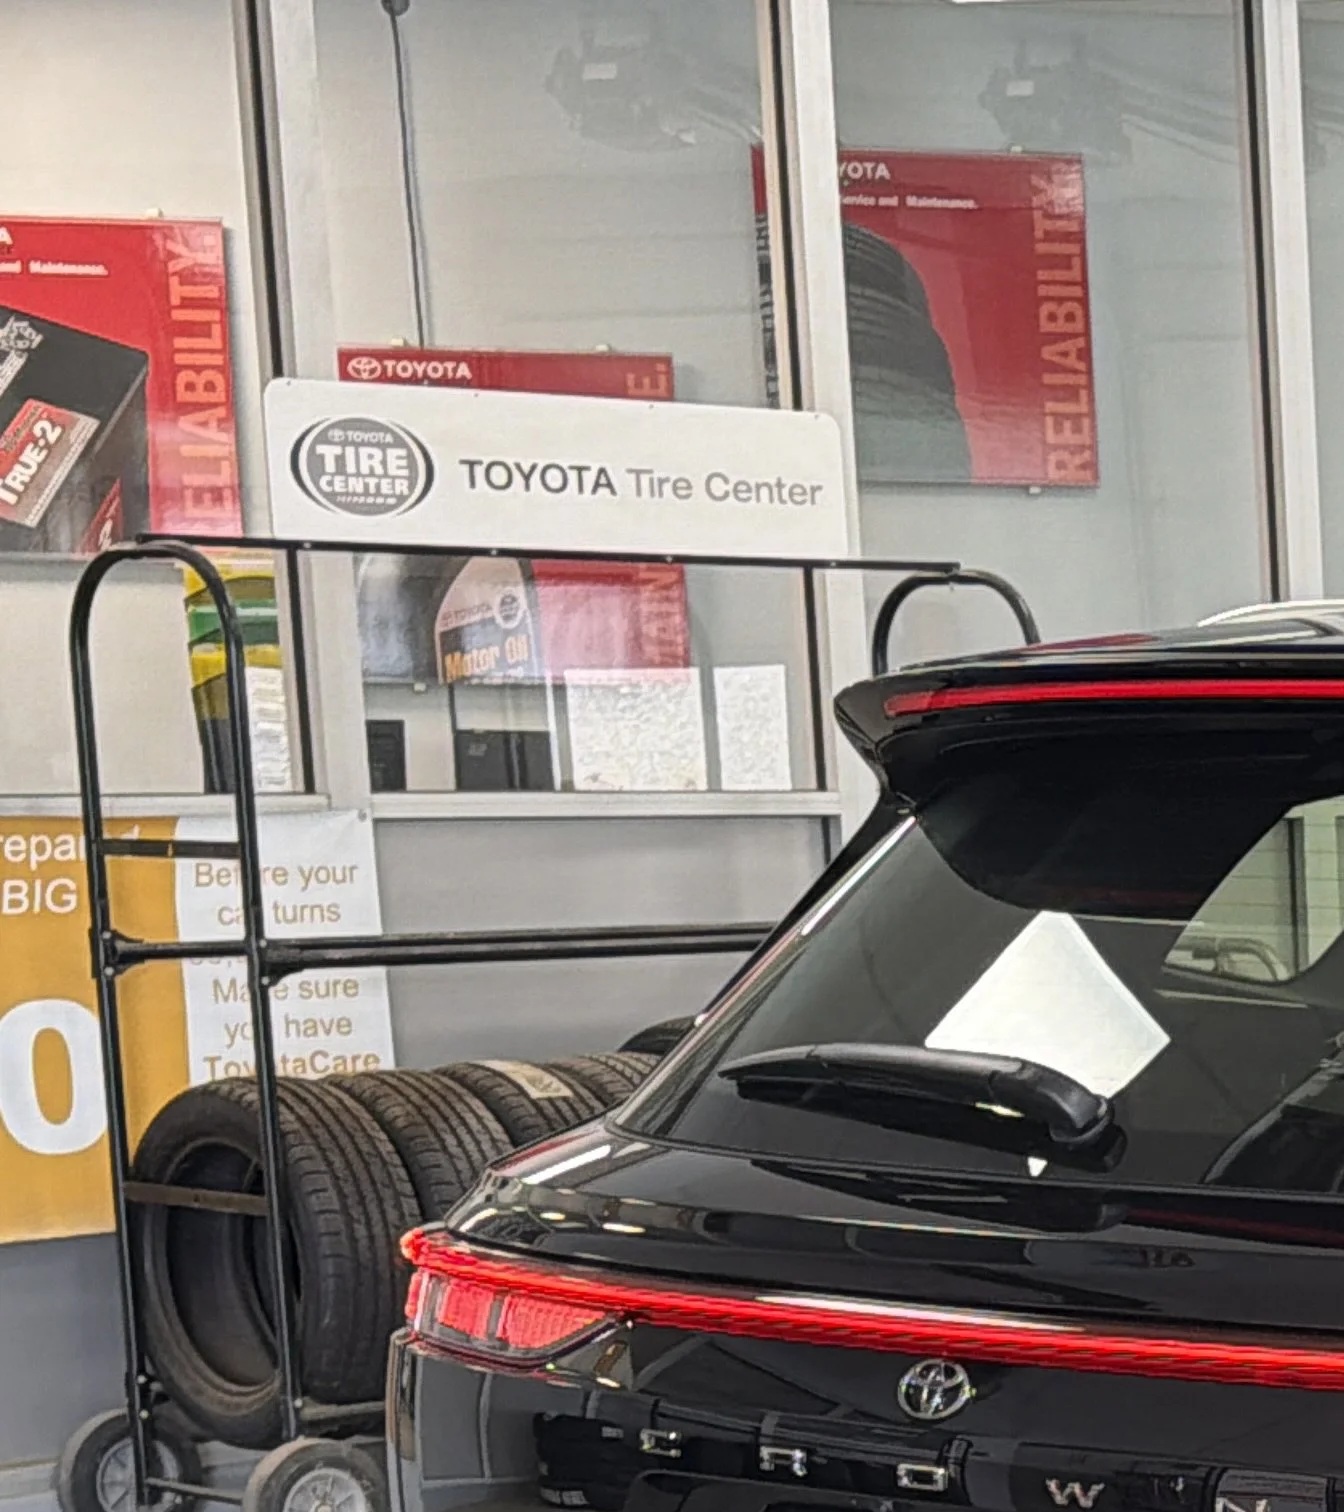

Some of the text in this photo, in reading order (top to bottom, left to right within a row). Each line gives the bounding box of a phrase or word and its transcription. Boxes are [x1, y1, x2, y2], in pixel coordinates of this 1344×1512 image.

[166, 233, 234, 519] ELIABILITY.
[381, 359, 473, 379] TOYOTA
[345, 430, 394, 445] TOYOTA
[315, 444, 409, 477] TIRE
[318, 474, 410, 497] CENTER
[458, 458, 824, 507] TOYOTA Tire Center
[299, 864, 359, 892] your
[1, 877, 78, 916] BIG
[272, 901, 342, 925] turns
[212, 975, 361, 1004] Mae sure
[284, 1012, 353, 1038] have
[203, 1048, 381, 1080] ToytaCare
